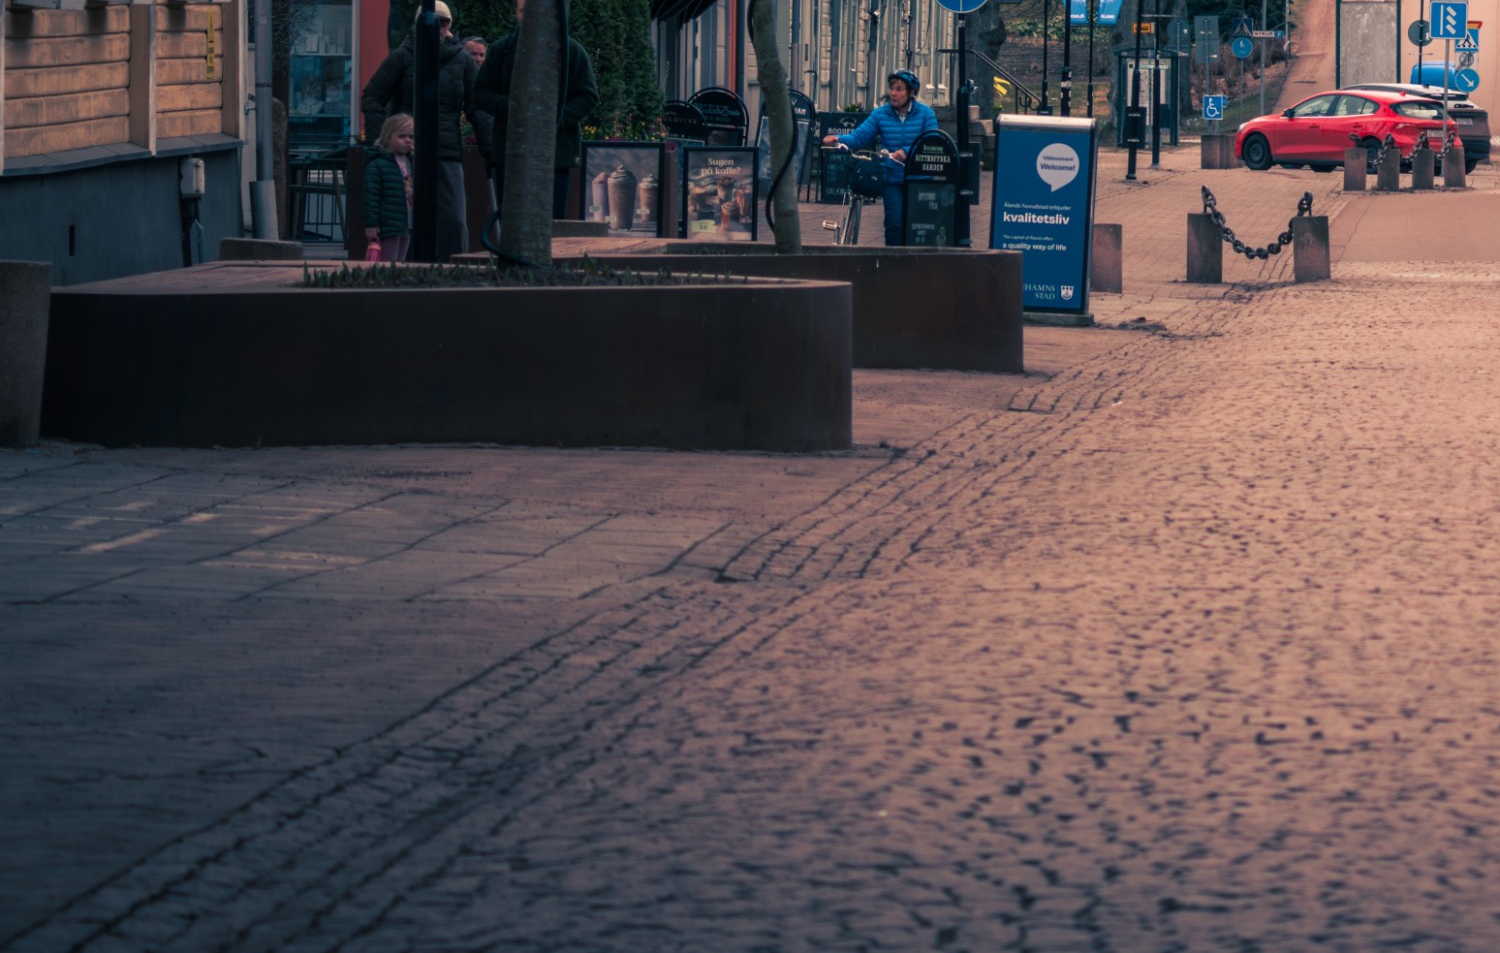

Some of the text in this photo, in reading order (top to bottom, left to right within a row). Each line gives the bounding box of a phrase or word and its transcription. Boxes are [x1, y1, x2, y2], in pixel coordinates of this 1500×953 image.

[707, 157, 734, 167] Sugen
[701, 166, 741, 176] på kaffe?
[1041, 163, 1076, 172] Welcome!
[1004, 201, 1021, 209] Ålands
[1049, 204, 1072, 212] erbjuder
[1003, 211, 1070, 226] kvalitetsliv
[1008, 242, 1032, 251] quality
[1032, 244, 1047, 252] way
[1055, 243, 1067, 252] life
[1034, 292, 1056, 300] STAD
